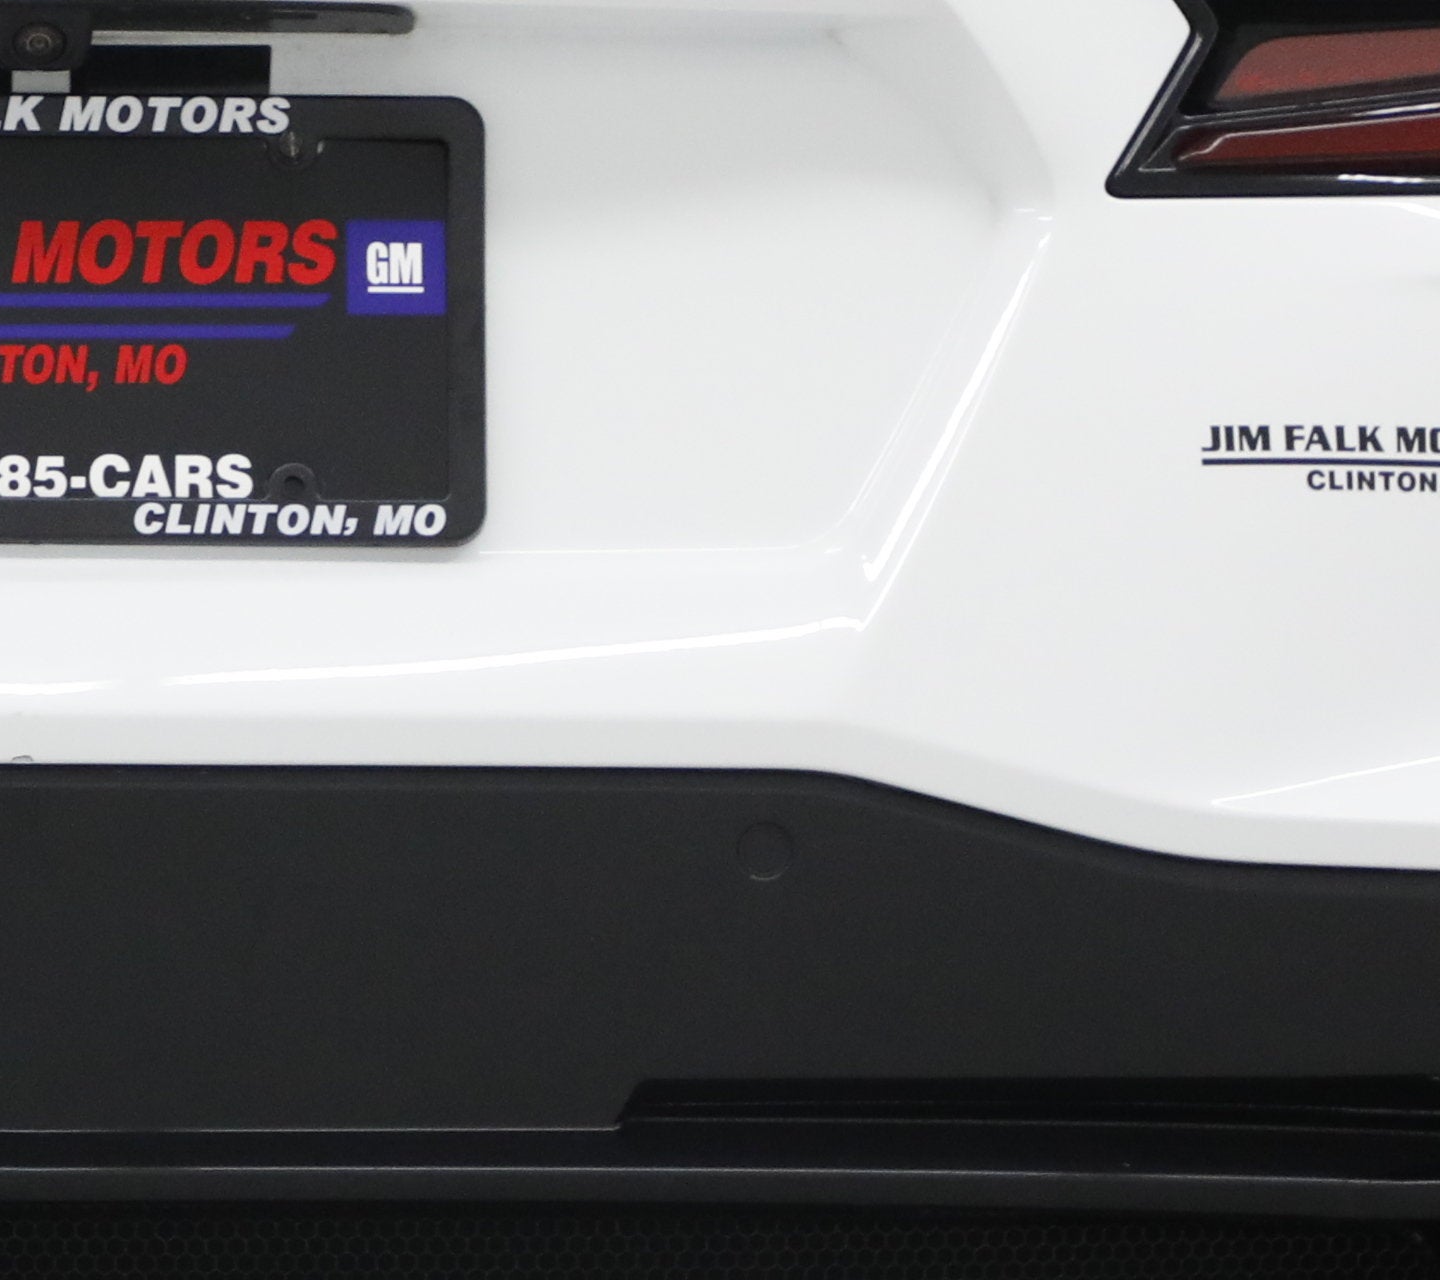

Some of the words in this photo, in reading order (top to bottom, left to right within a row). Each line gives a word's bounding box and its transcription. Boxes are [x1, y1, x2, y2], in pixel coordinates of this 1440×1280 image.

[59, 96, 291, 134] MOTORS
[10, 219, 338, 285] MOTORS
[366, 242, 424, 286] GM
[113, 344, 187, 385] MO
[1201, 425, 1272, 452] JIM
[1284, 425, 1385, 453] FALK
[132, 502, 360, 537] CLINTON,
[373, 504, 448, 537] MO
